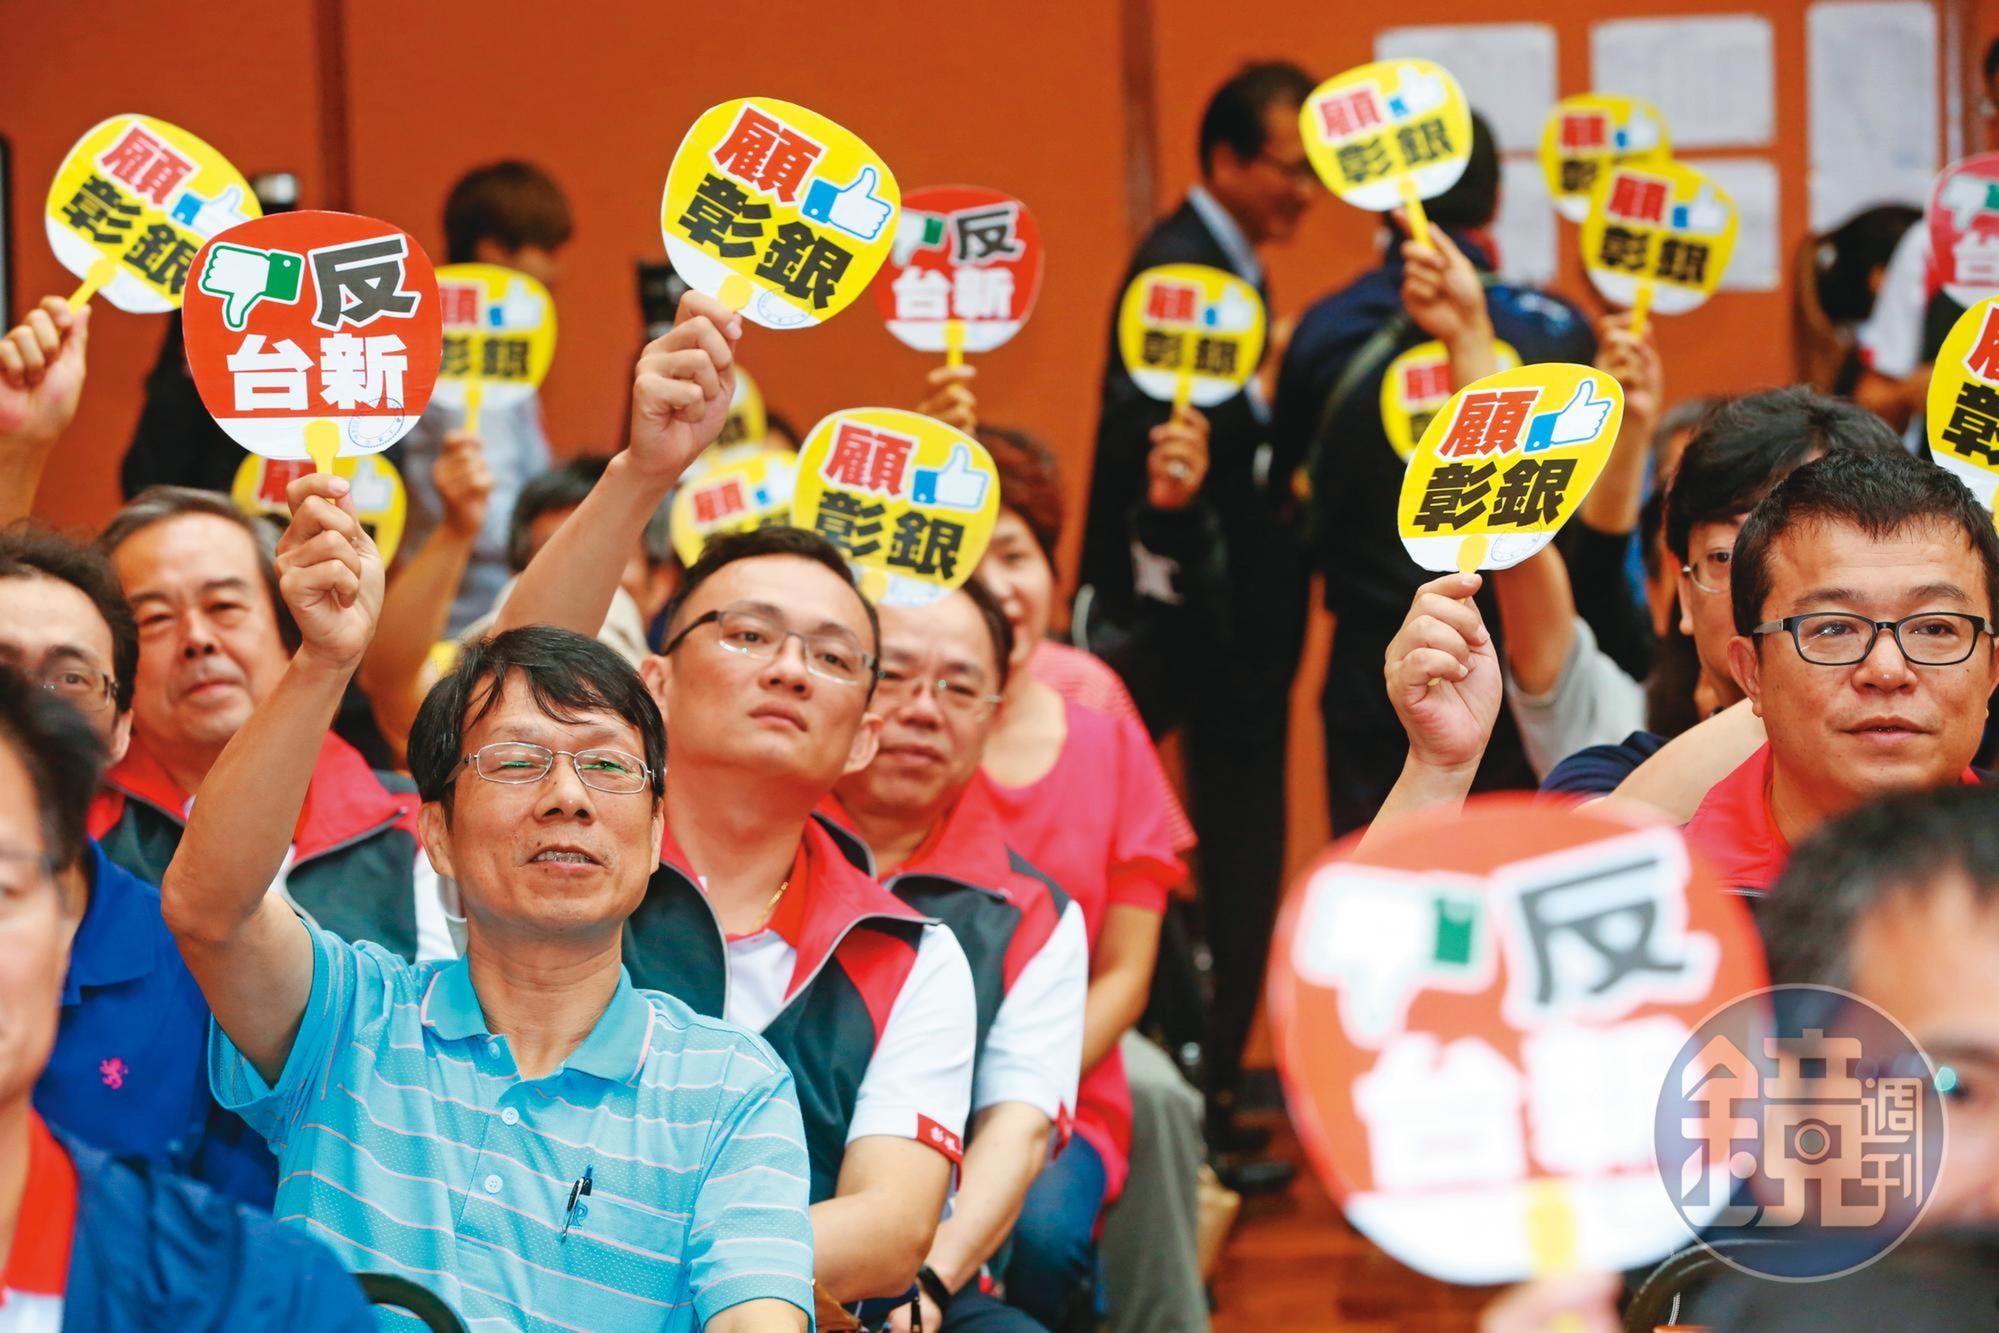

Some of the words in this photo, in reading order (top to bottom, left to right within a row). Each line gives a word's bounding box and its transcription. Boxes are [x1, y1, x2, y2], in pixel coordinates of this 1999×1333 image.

[101, 127, 193, 205] 顧
[714, 107, 822, 203] 顧
[62, 175, 199, 295] 彰銀
[678, 172, 854, 310] 彰銀
[957, 210, 1015, 260] 反
[313, 238, 416, 327] 反
[226, 333, 407, 411] 台新
[825, 423, 913, 497] 顧
[1439, 390, 1540, 458] 顧
[1942, 371, 1999, 466] 彰
[812, 490, 965, 581] 彰銀
[1412, 458, 1578, 532] 彰銀
[1520, 858, 1685, 1004] 反
